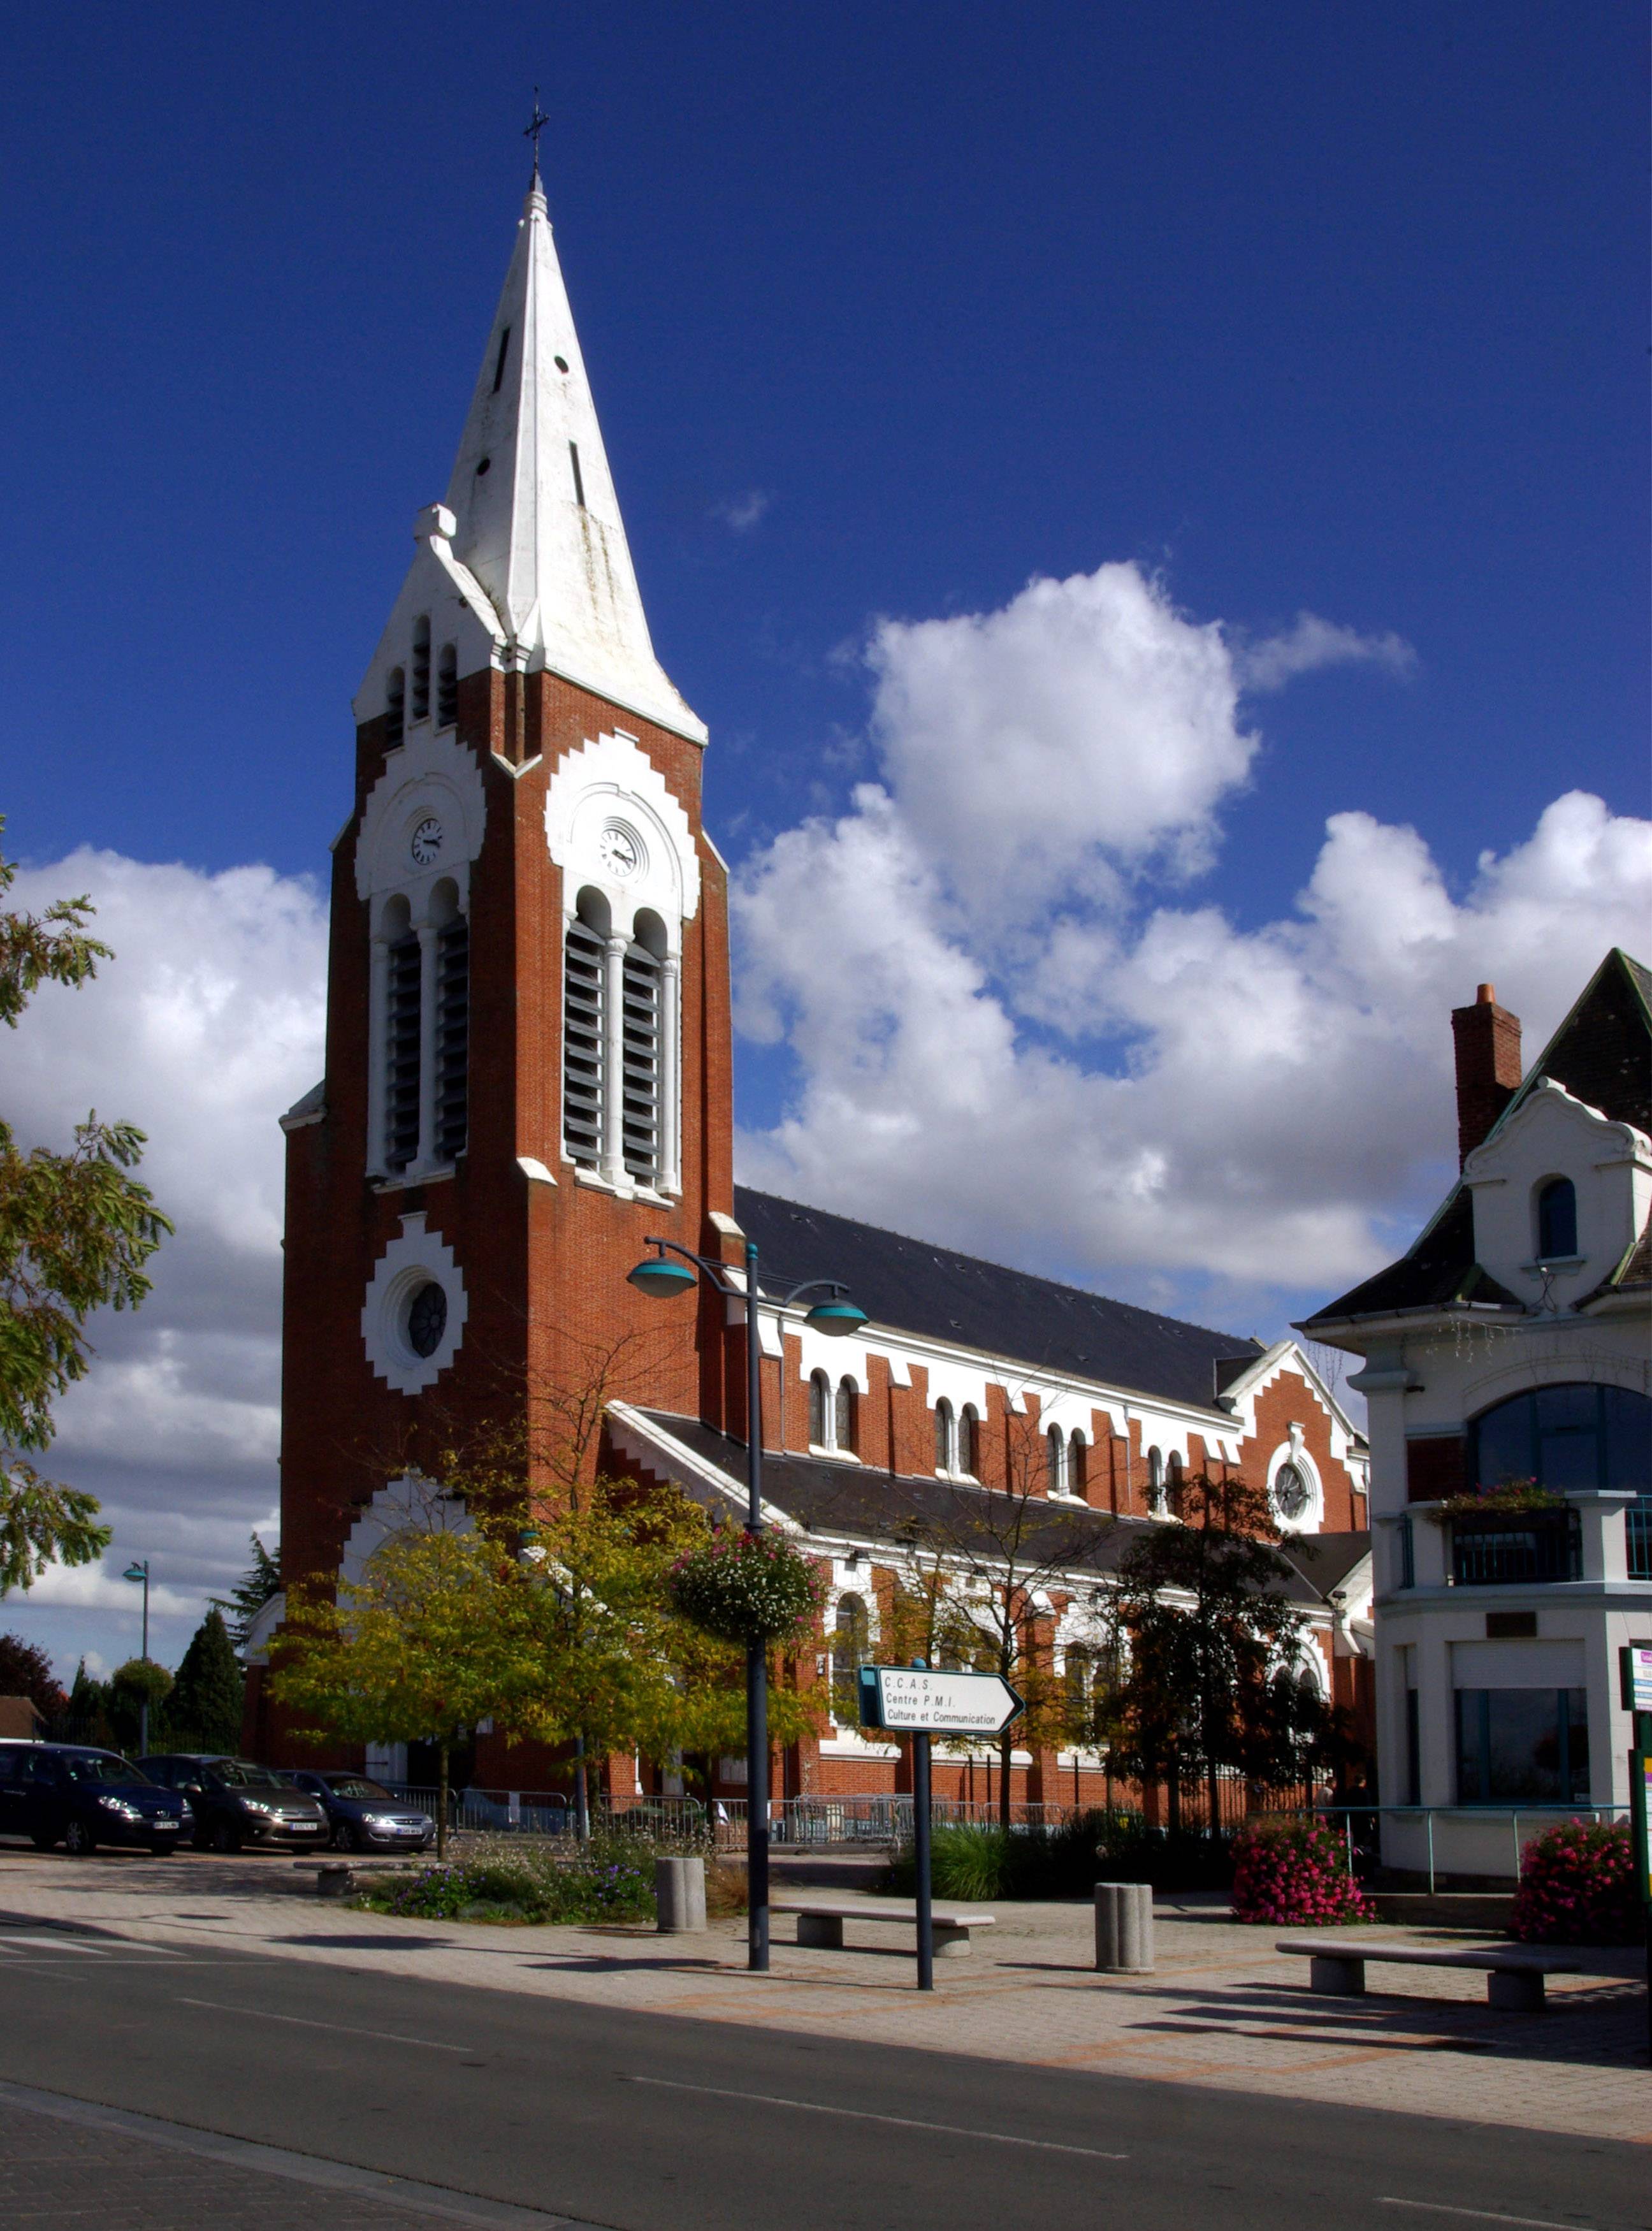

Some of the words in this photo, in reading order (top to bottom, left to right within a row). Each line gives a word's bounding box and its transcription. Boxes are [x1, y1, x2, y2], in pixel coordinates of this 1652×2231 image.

[885, 1676, 932, 1690] C.C.A.S.
[887, 1692, 918, 1705] Centre
[924, 1695, 956, 1708] P.M.I.
[888, 1709, 916, 1721] Culture
[920, 1713, 929, 1722] et
[933, 1711, 996, 1725] Communication
